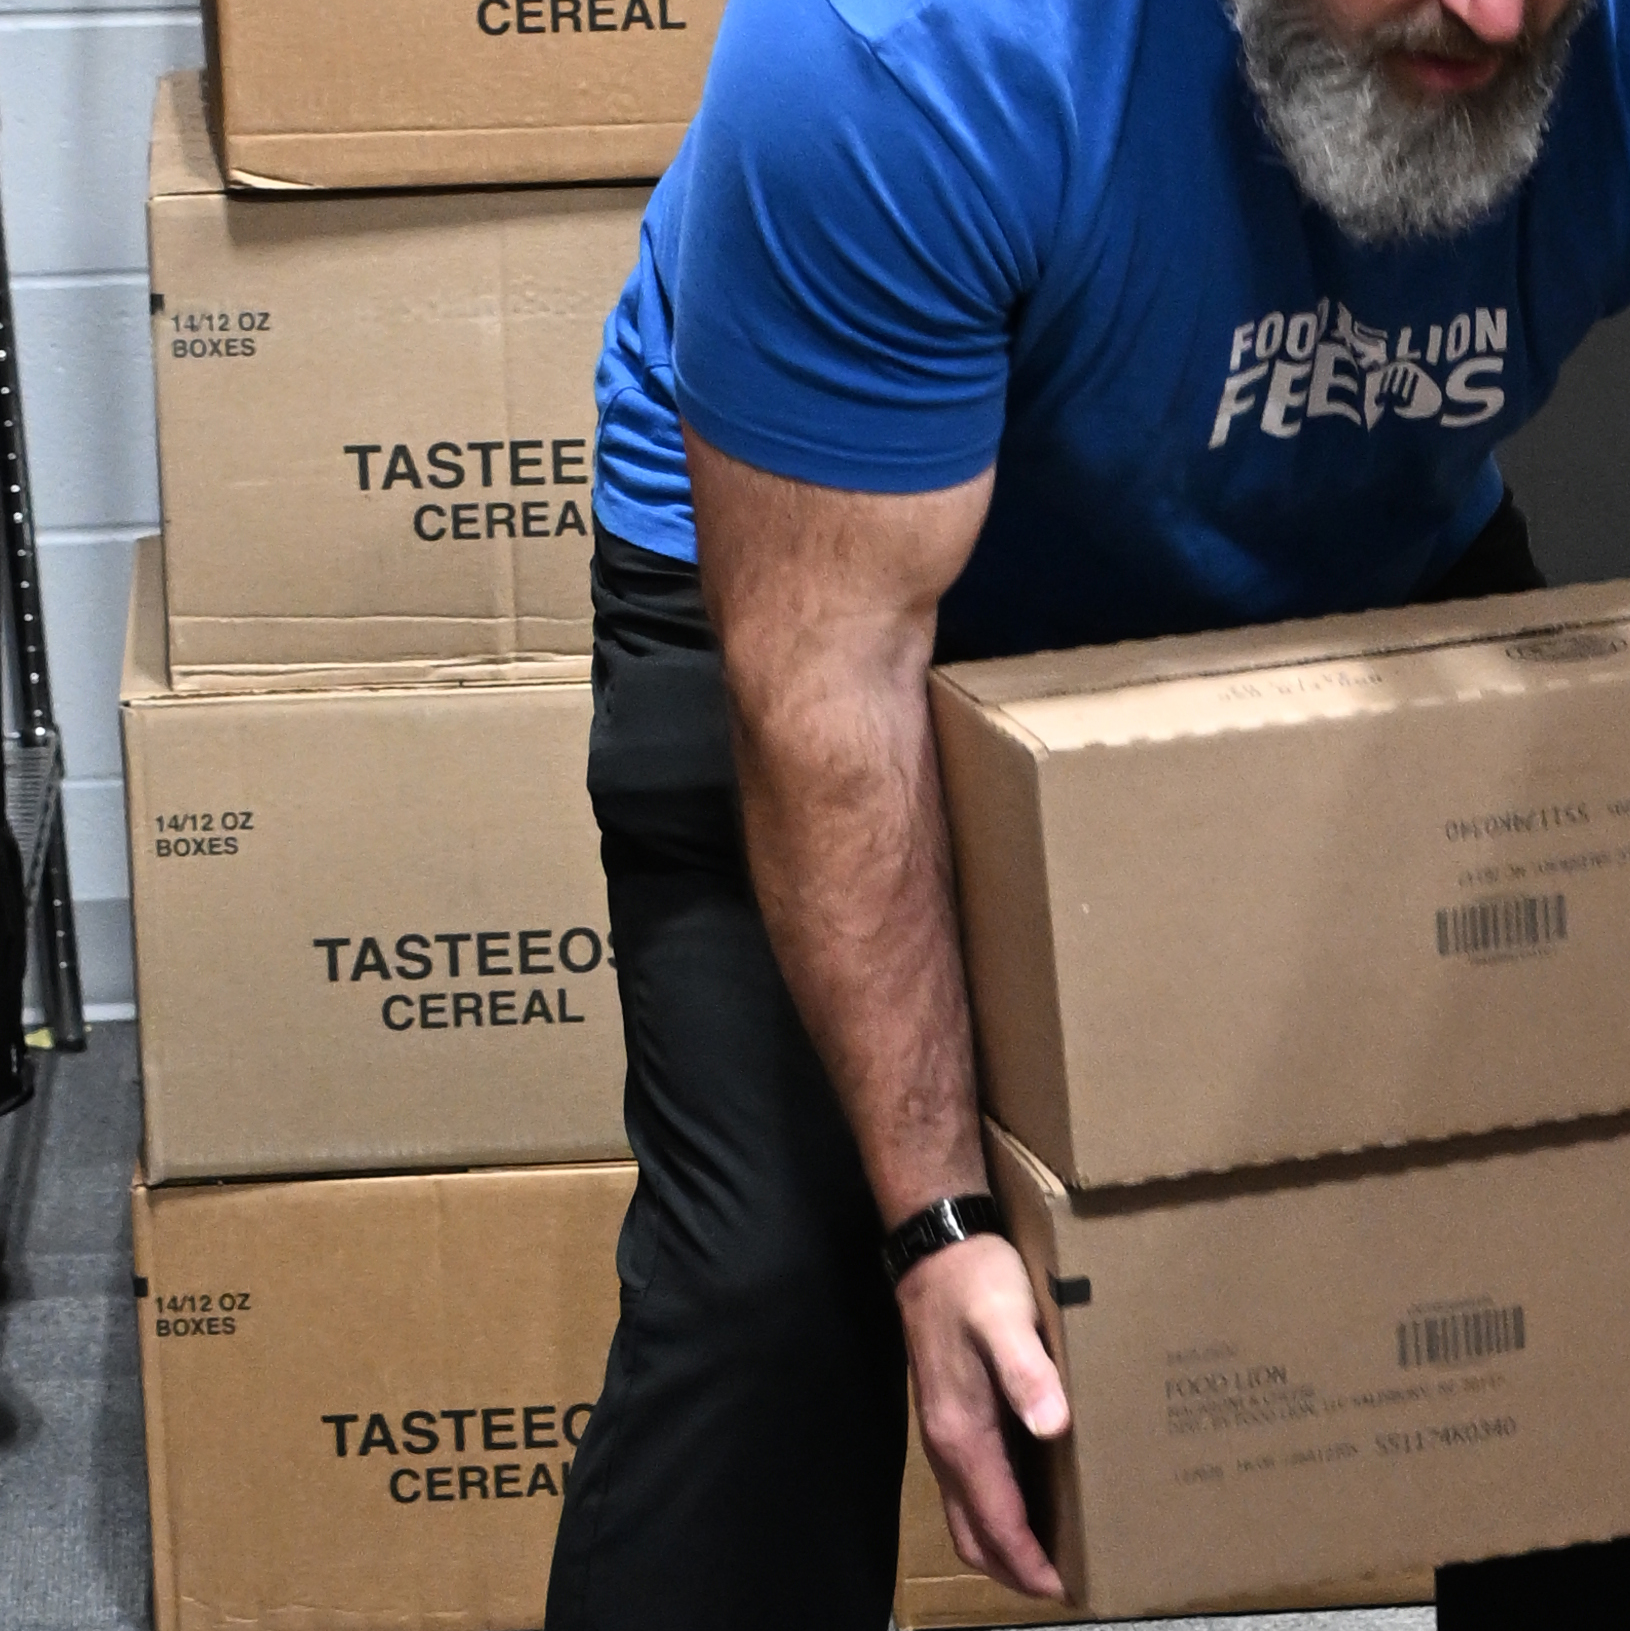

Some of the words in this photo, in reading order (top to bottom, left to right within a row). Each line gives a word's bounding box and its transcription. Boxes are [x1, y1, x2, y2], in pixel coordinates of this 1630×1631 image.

[170, 313, 231, 334] 14/12
[238, 312, 271, 332] OZ
[1397, 306, 1508, 366] LION
[171, 337, 257, 358] BOXES
[344, 437, 589, 492] TASTEE
[413, 499, 588, 542] CEREA
[154, 813, 213, 832] 14/12
[220, 811, 254, 830] OZ
[155, 836, 240, 857] BOXES
[381, 988, 586, 1032] CEREAL
[154, 1294, 213, 1314] 14/12
[219, 1292, 252, 1312] OZ
[155, 1317, 237, 1338] BOXES
[321, 1402, 600, 1458] TASTEEO
